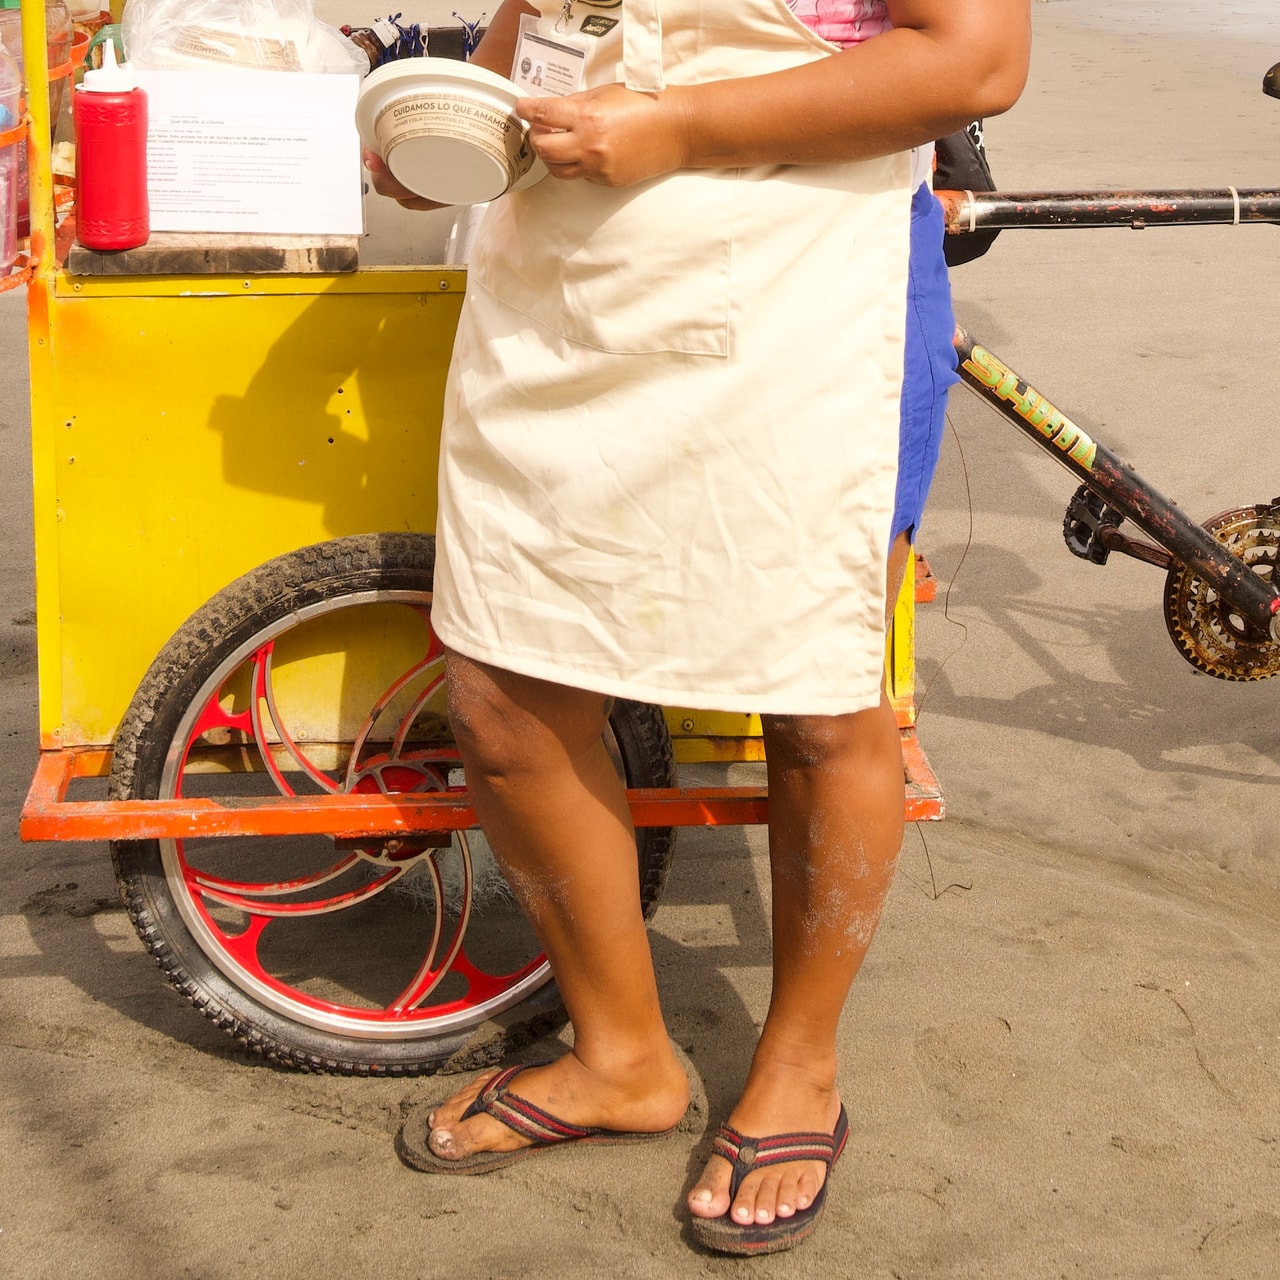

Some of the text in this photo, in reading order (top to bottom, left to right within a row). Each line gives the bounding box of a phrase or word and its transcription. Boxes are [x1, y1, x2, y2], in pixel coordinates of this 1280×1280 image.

[393, 102, 511, 133] CUIDAMOS LO QUE AMAMOS
